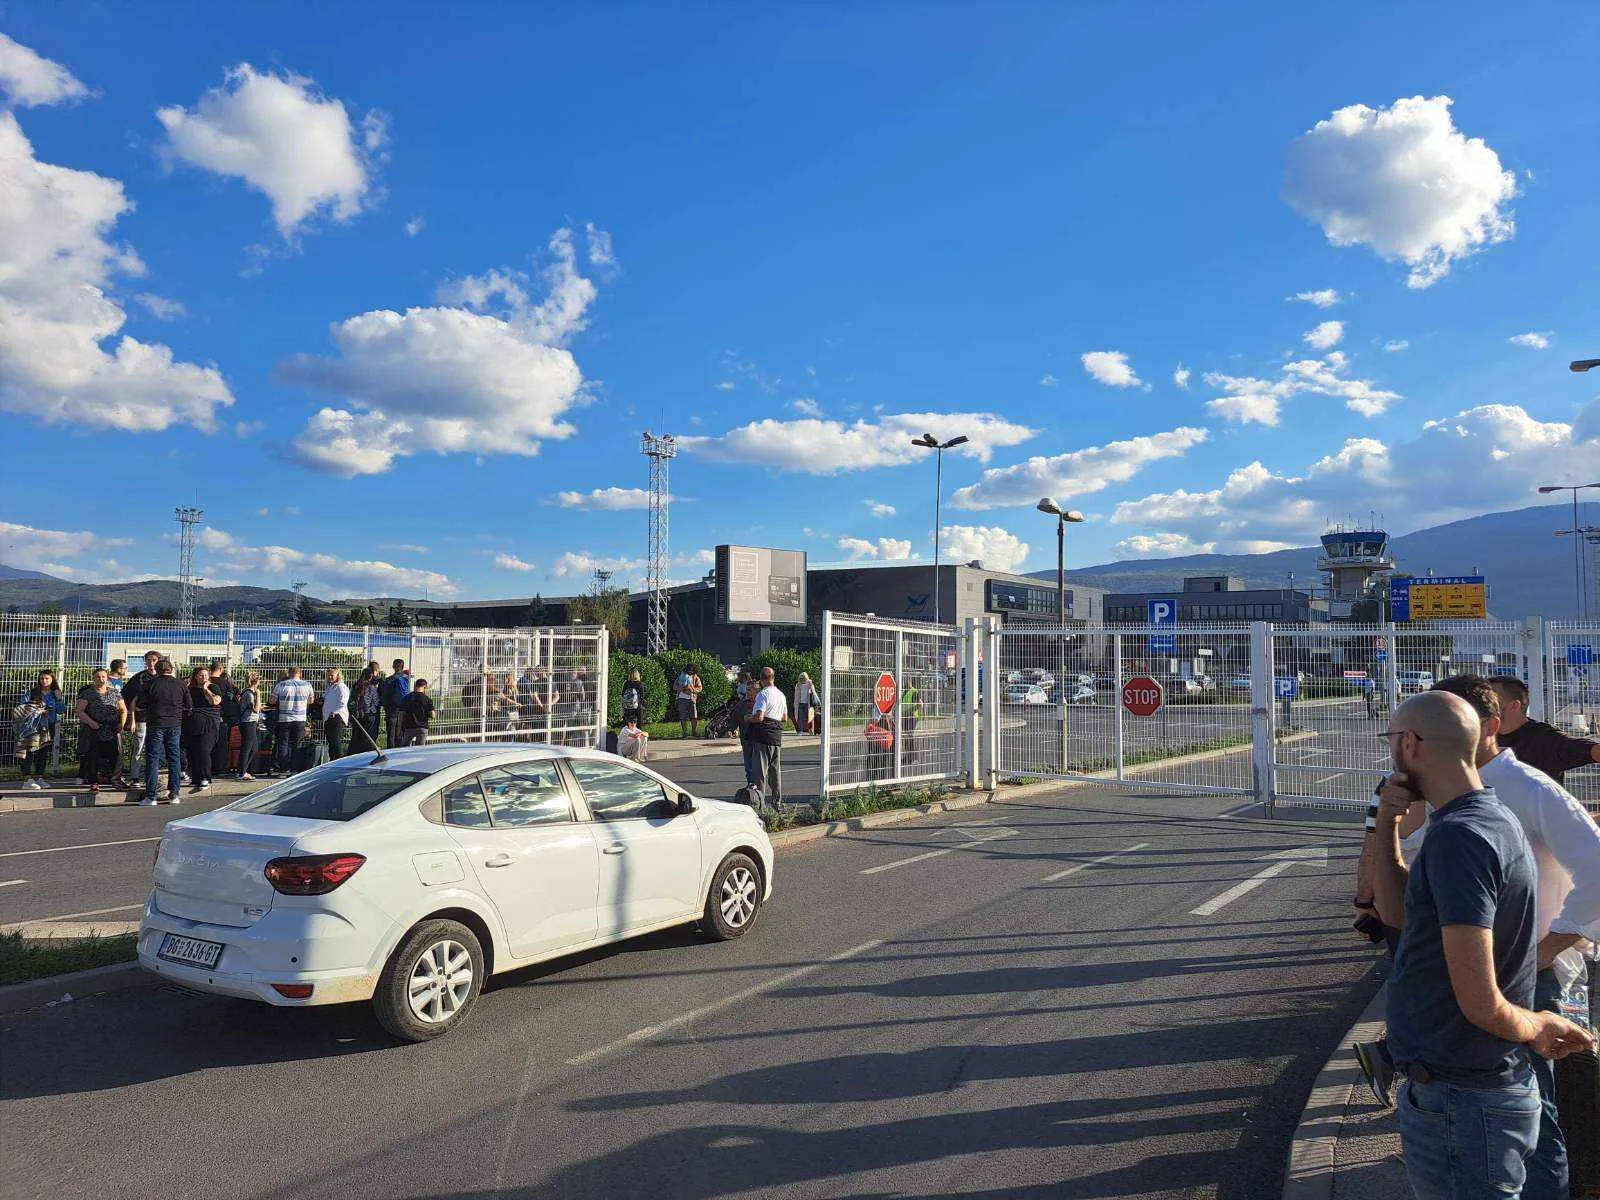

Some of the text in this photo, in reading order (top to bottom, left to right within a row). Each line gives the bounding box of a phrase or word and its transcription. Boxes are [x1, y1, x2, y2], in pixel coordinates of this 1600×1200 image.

[1154, 602, 1170, 623] P
[876, 686, 895, 702] STOP
[1280, 680, 1291, 695] P
[1124, 689, 1159, 705] STOP
